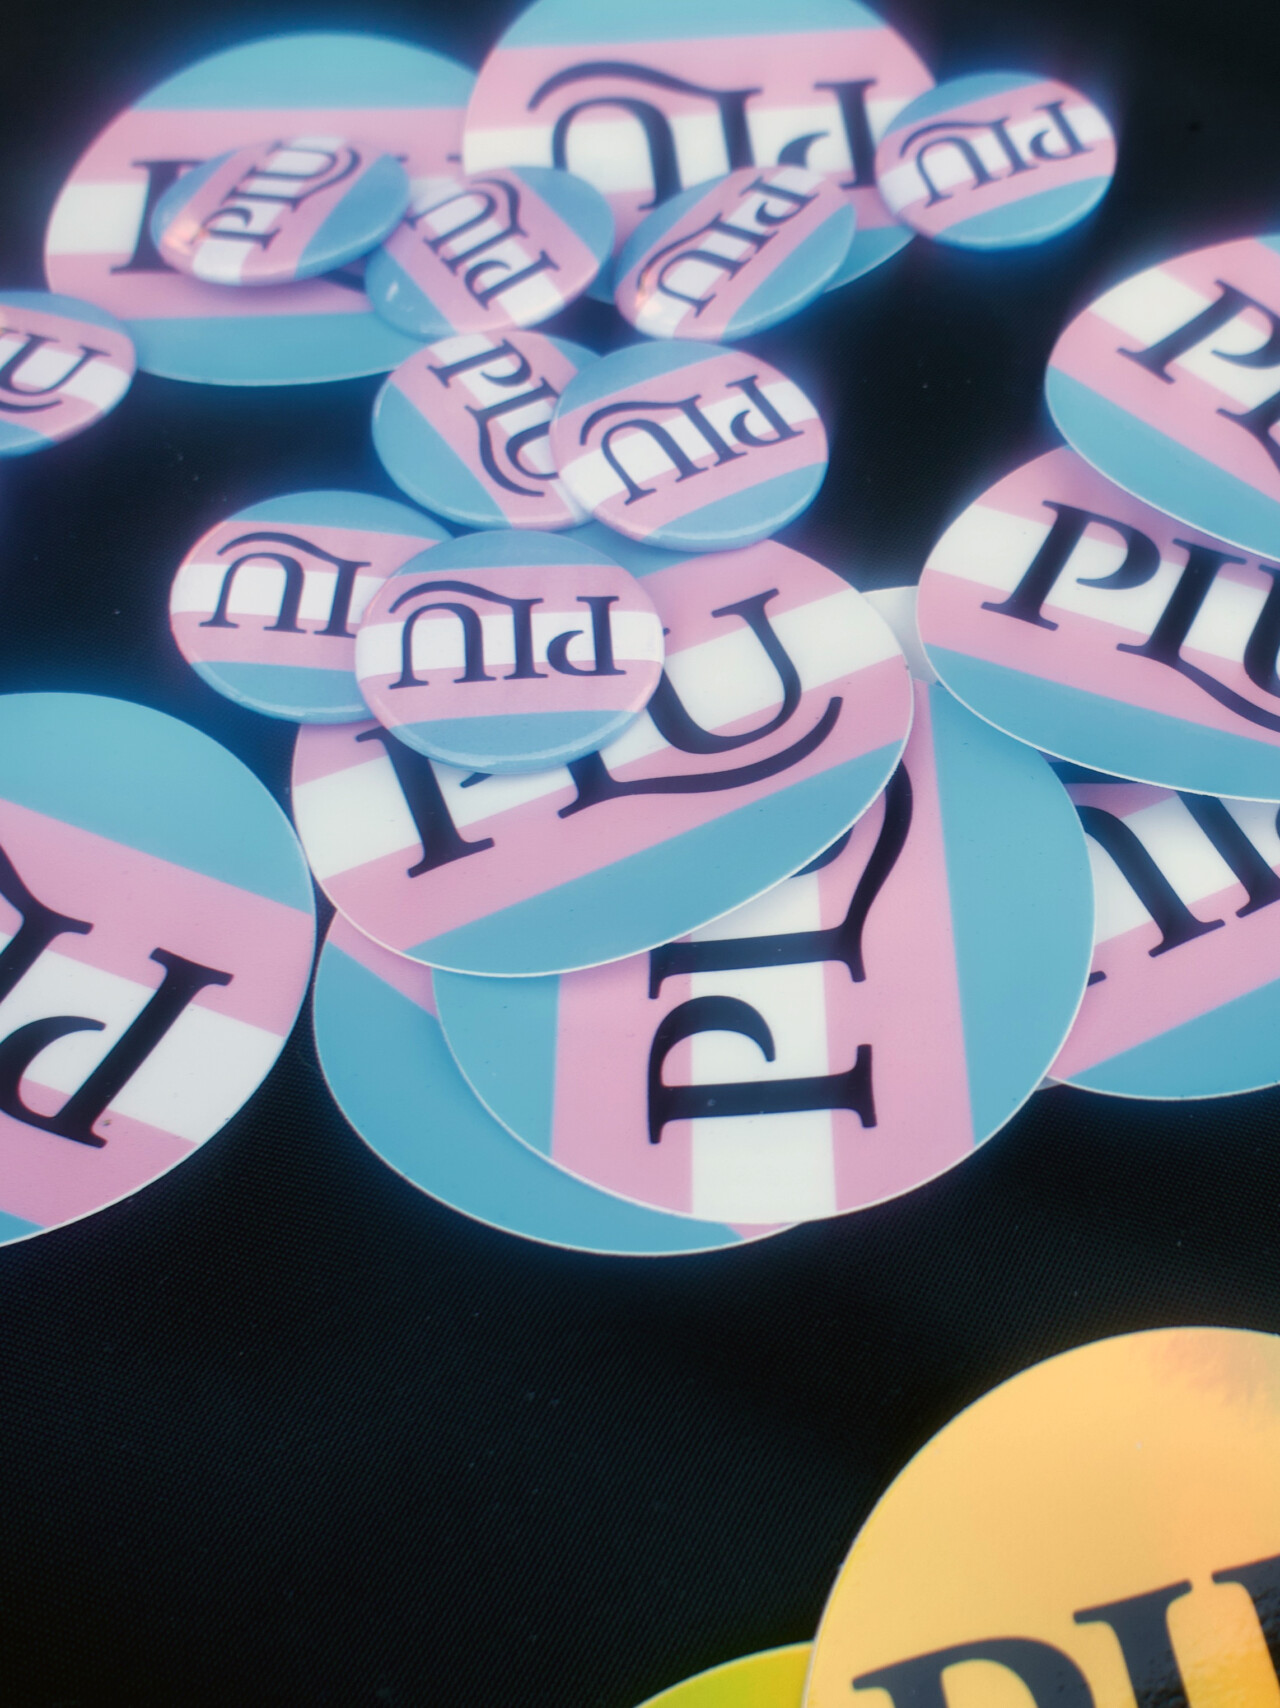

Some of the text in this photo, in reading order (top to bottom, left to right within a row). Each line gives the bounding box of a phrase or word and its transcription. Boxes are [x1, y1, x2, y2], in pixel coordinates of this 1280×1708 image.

[900, 101, 1094, 208] PLU
[404, 178, 560, 311] PLU
[636, 176, 819, 318] PLU
[580, 375, 804, 505] PLU
[200, 531, 371, 638] LU
[389, 580, 627, 690] PLU
[647, 760, 913, 1145] PL
